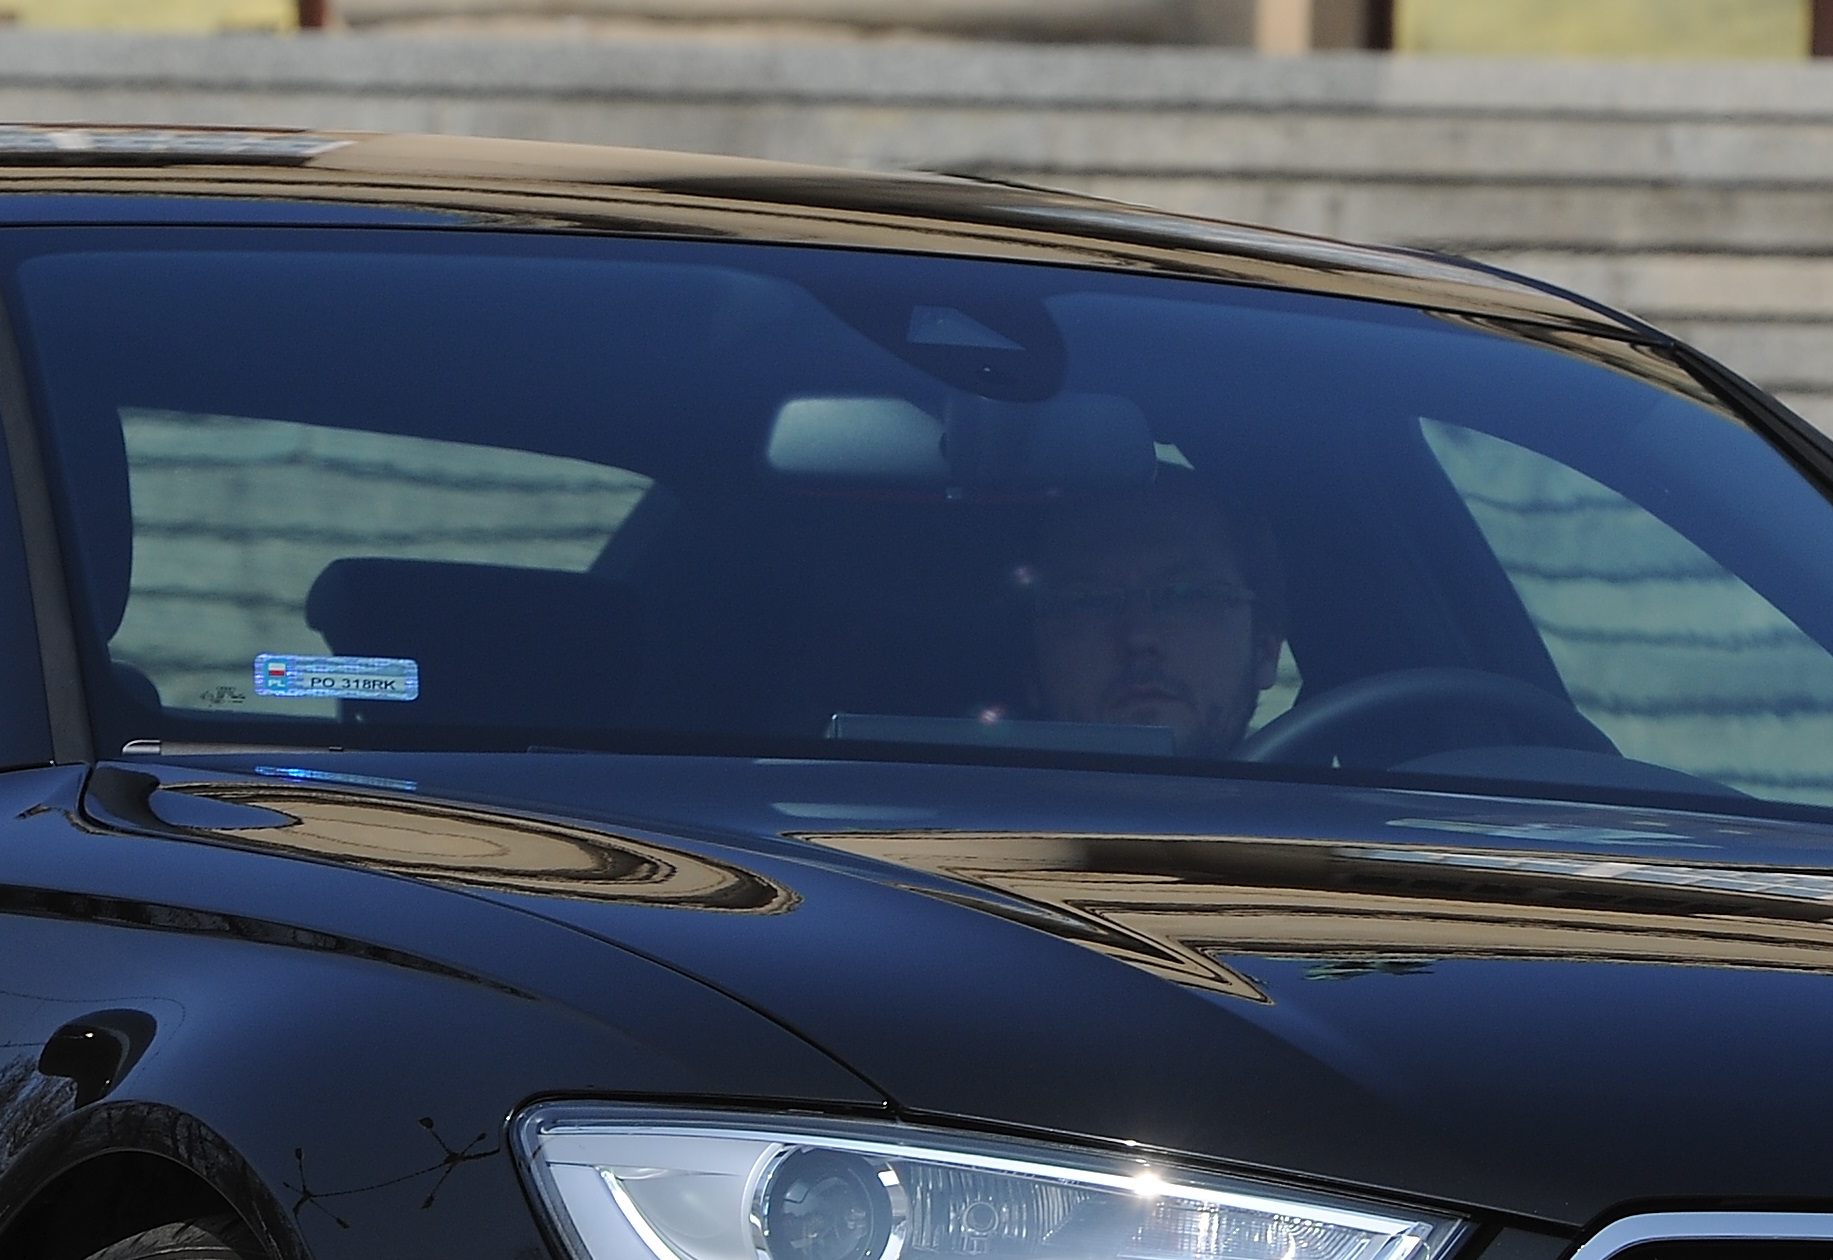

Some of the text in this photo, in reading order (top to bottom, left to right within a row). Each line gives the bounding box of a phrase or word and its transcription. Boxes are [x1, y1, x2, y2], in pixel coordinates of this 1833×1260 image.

[268, 679, 286, 687] PL
[310, 677, 396, 691] PO 318RK
